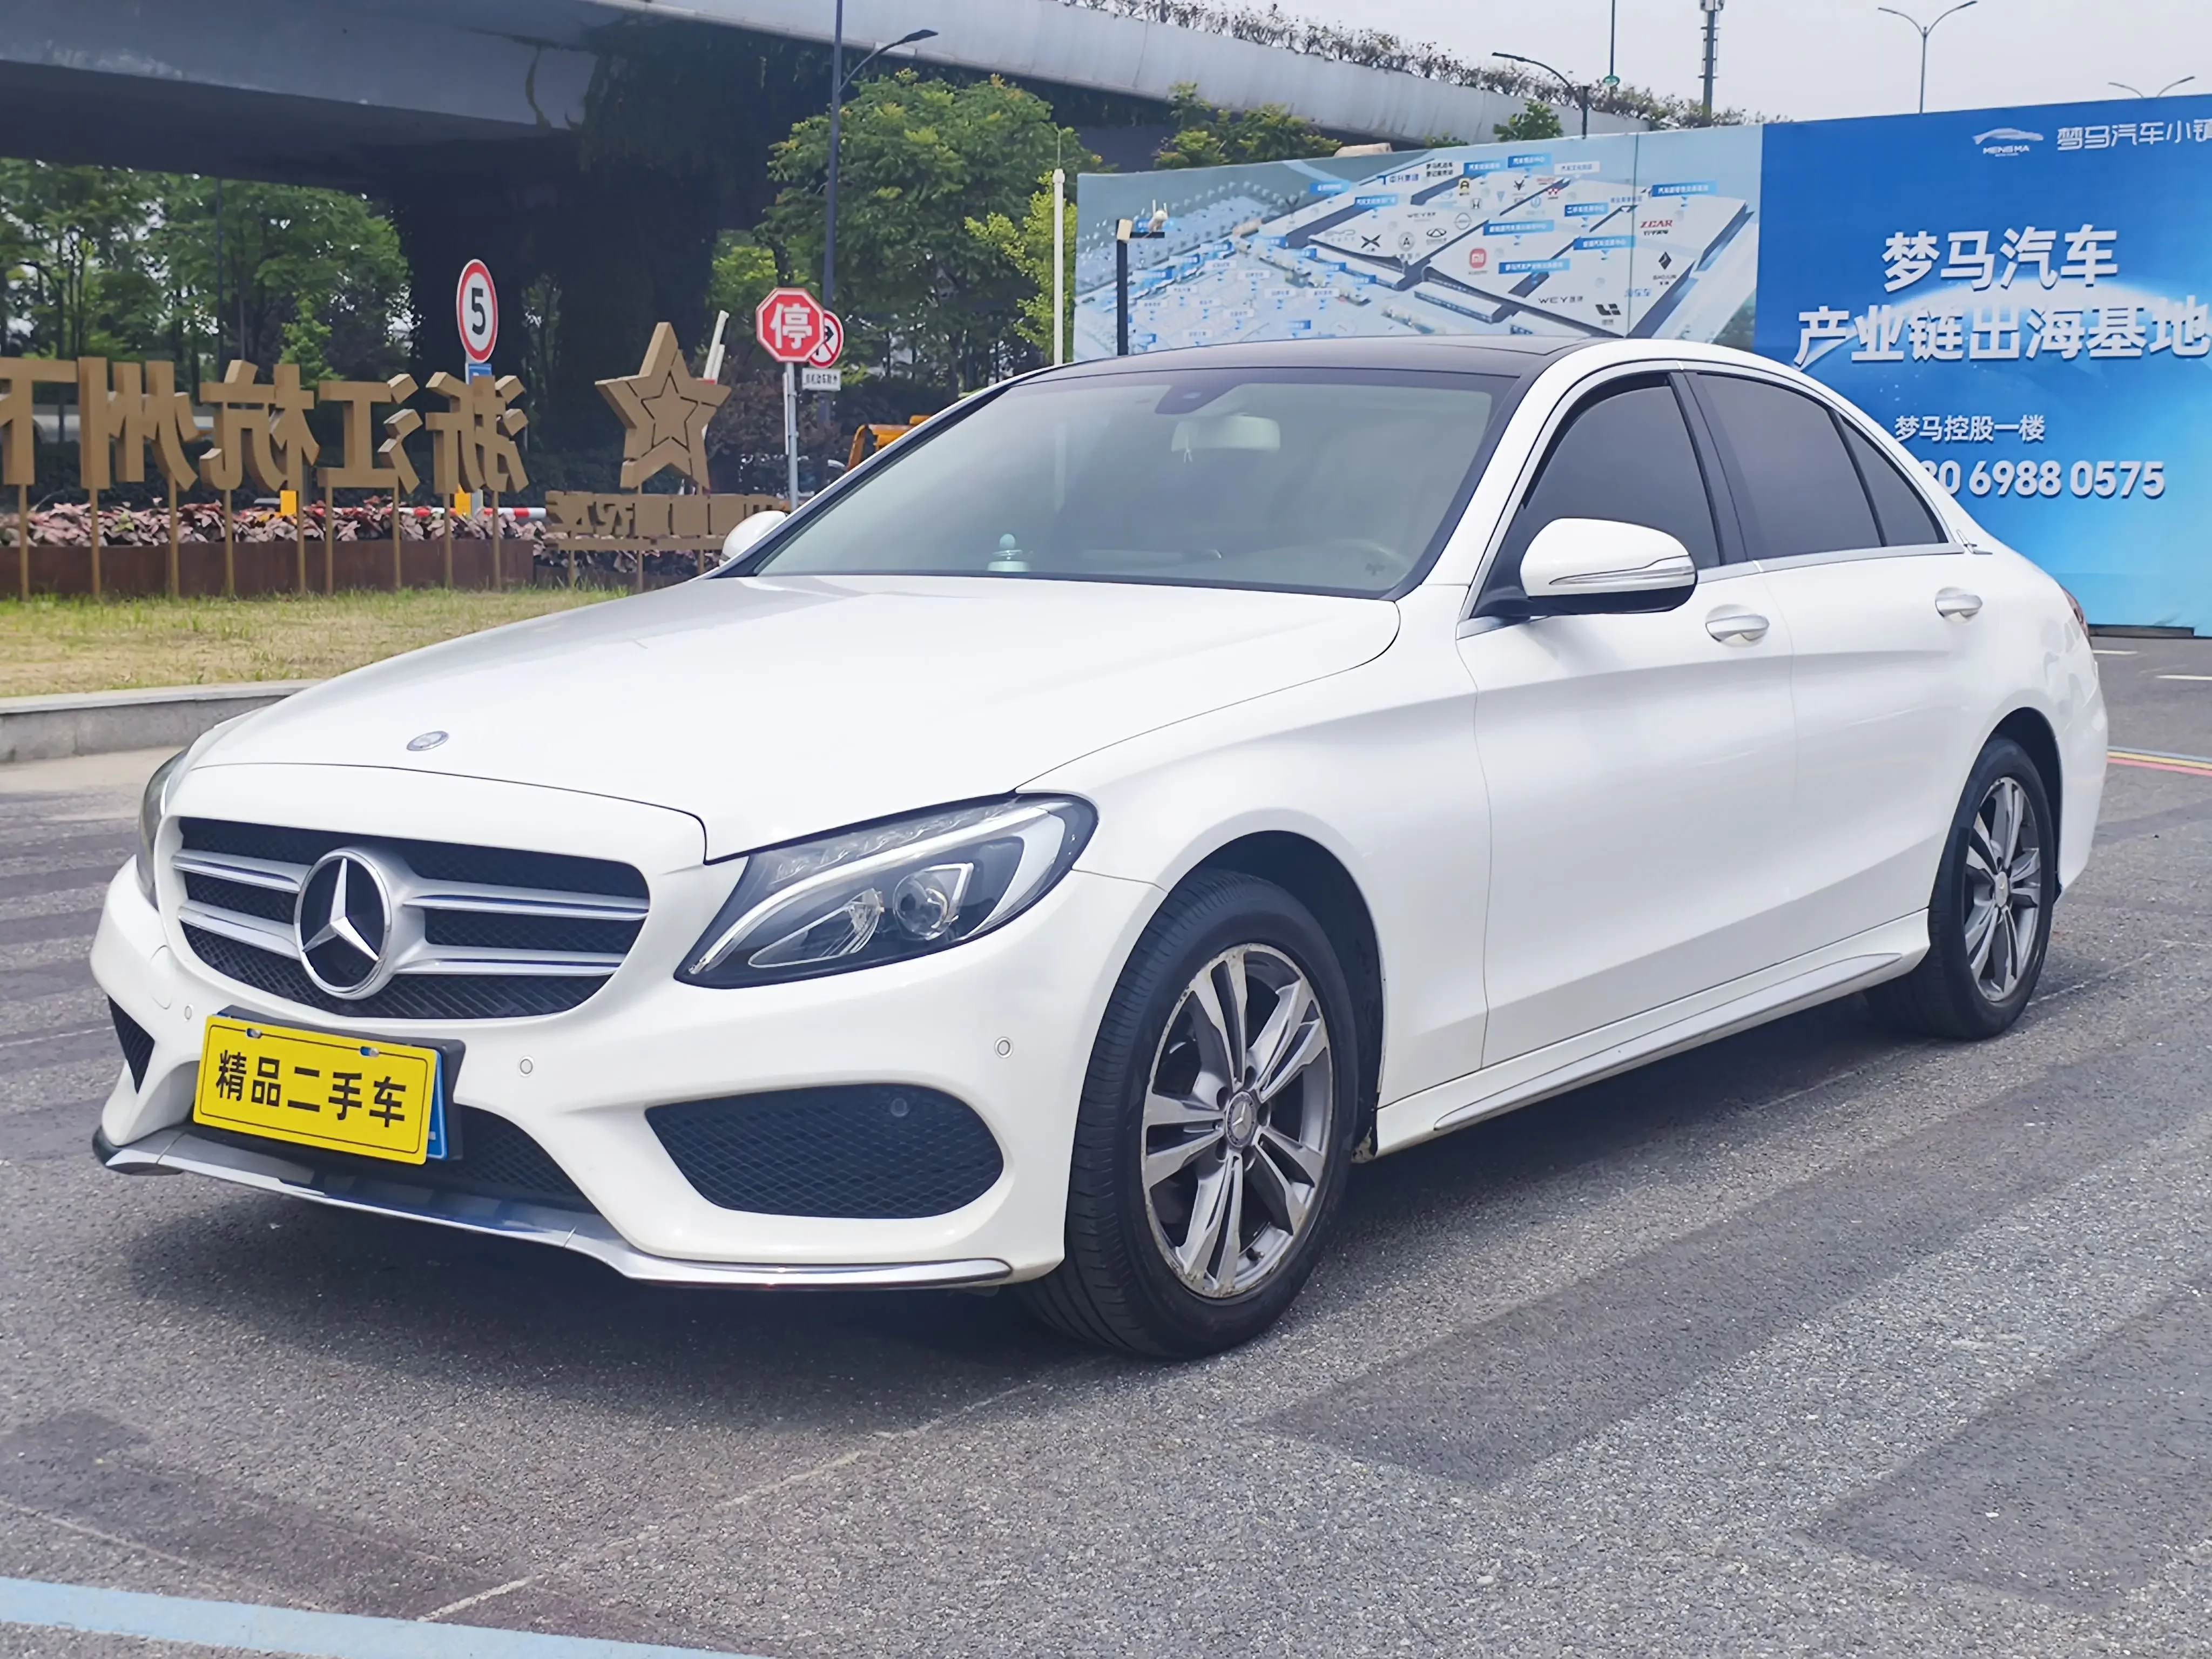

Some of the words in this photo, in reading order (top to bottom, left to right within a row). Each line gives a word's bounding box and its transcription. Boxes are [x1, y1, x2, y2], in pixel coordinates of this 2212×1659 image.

[1882, 224, 2118, 292] 梦马汽车
[471, 287, 486, 335] 5
[769, 302, 812, 349] 停
[1793, 295, 2210, 370] 产业链出海基地
[1894, 415, 2045, 442] 梦马控股一楼
[1968, 460, 2062, 496] 6988
[2069, 461, 2164, 497] 0575
[216, 1049, 407, 1128] 精品二手车
